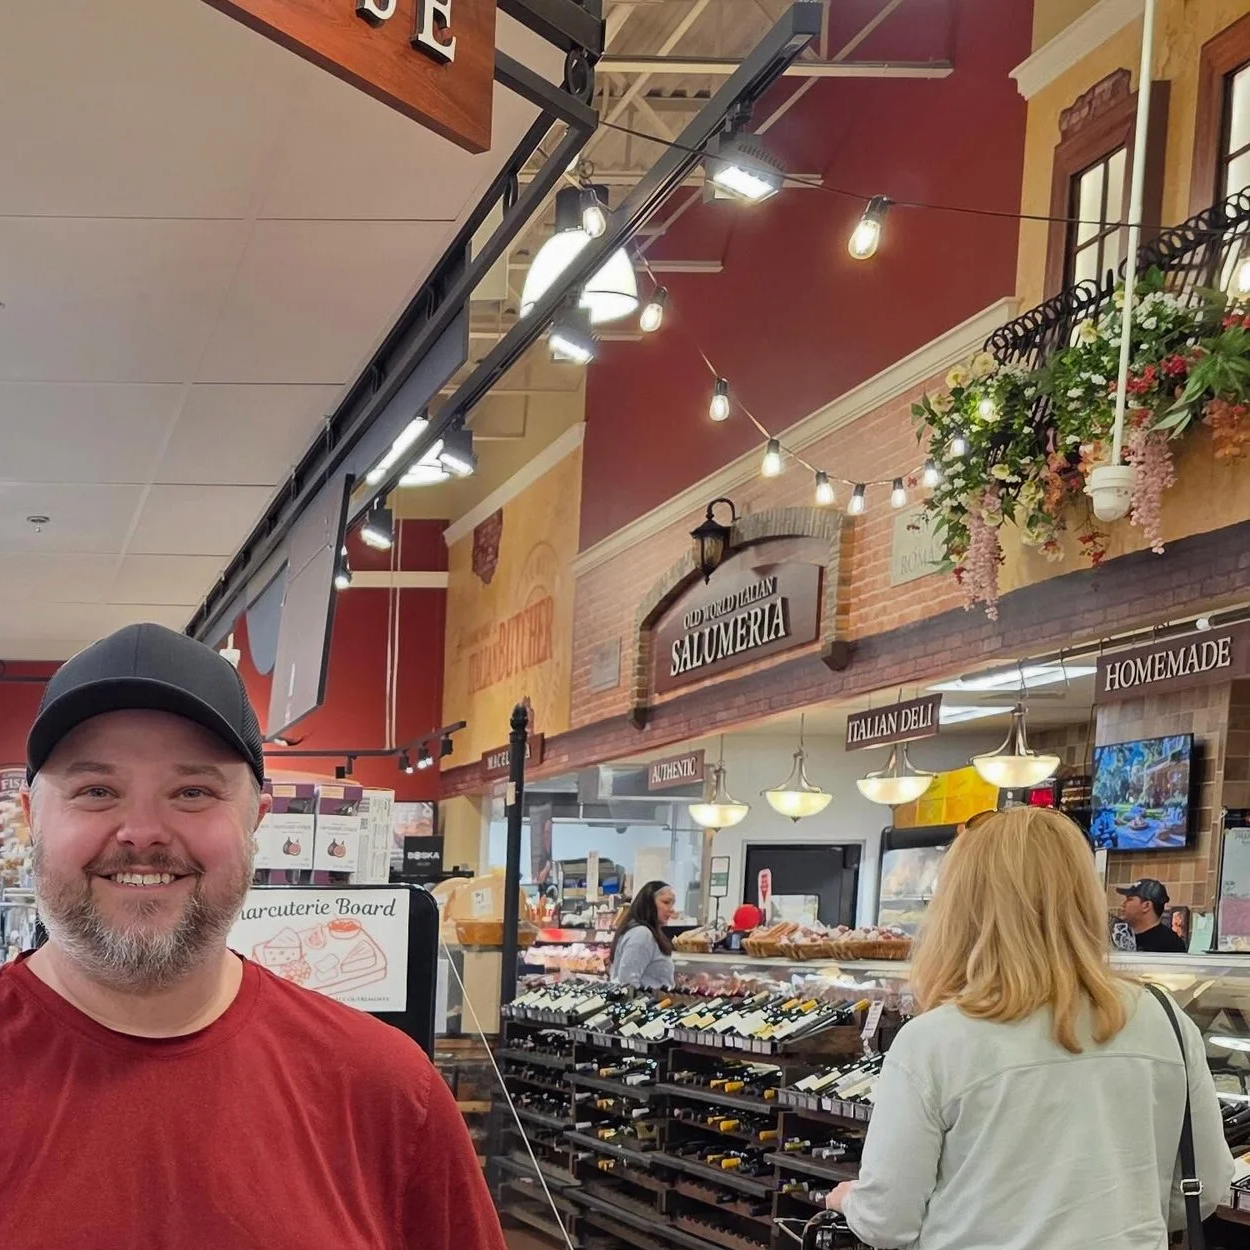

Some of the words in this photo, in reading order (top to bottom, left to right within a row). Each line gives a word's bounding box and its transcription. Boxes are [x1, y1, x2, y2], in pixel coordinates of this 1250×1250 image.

[684, 609, 702, 630] OLD
[703, 595, 735, 621] WORLD
[736, 576, 775, 609] ITALIAN
[670, 597, 787, 677] SALUMERIA
[1104, 636, 1232, 692] HOMEMADE
[848, 710, 897, 743] ITALIAN
[901, 703, 933, 730] DELI
[652, 756, 696, 783] AUTHENTIC
[335, 897, 396, 917] Board
